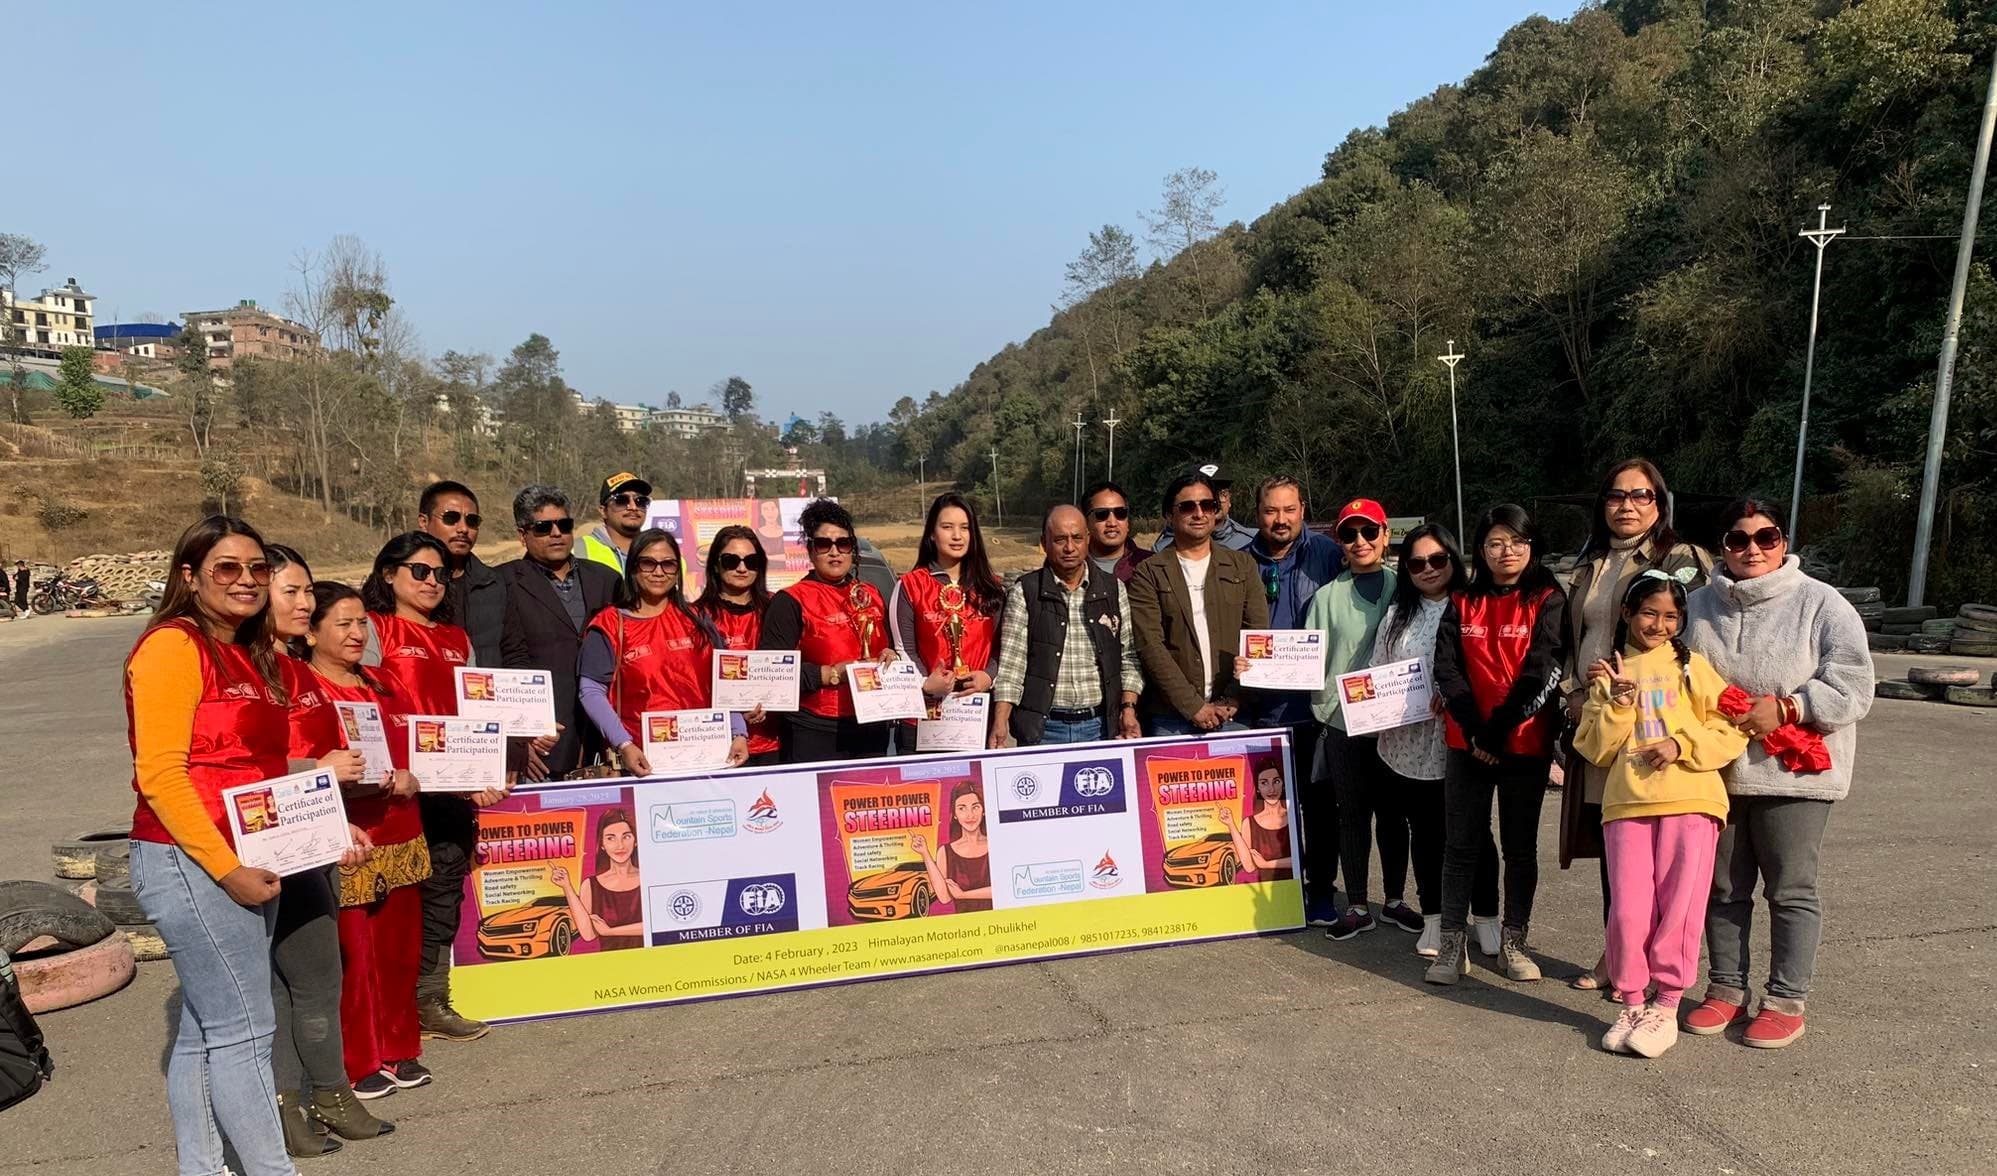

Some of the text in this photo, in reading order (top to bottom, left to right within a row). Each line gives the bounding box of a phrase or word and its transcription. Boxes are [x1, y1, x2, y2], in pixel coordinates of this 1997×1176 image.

[1274, 645, 1312, 653] Certificate
[1274, 653, 1319, 661] Participation
[749, 674, 794, 682] Participation
[1375, 674, 1423, 690] Certificate of
[495, 686, 546, 695] Certificate of
[1376, 683, 1425, 698] Participation
[496, 695, 547, 704] Participation
[679, 724, 724, 734] Certificate of
[447, 735, 499, 744] Certificate of
[679, 733, 726, 742] Participation
[447, 745, 499, 755] Participation
[1158, 767, 1236, 784] POWER TO POWER
[1158, 779, 1238, 805] STEERING
[277, 796, 323, 813] Certificate
[325, 791, 334, 801] of
[843, 792, 930, 810] POWER TO POWER
[280, 806, 337, 826] Participation
[1022, 803, 1105, 819] MEMBER OF FIA
[707, 814, 733, 825] Sports
[844, 805, 933, 834] STEERING
[517, 824, 531, 837] TO
[534, 821, 574, 836] POWER
[655, 828, 703, 839] Federation
[474, 833, 576, 865] STEERING
[506, 867, 546, 876] Empowerment
[484, 876, 513, 884] Adventure
[520, 874, 543, 882] Thrilling
[1060, 873, 1081, 882] Sports
[503, 889, 535, 897] Networking
[1017, 885, 1056, 896] Federation
[679, 923, 774, 941] MEMBER OF FIA
[733, 953, 763, 965] Date:
[765, 952, 772, 961] 4
[775, 947, 824, 961] February
[832, 942, 858, 954] 2023
[868, 934, 924, 949] Himalayan
[927, 927, 981, 941] Motorland
[988, 920, 1037, 936] Dhulikhel
[594, 986, 627, 1000] NASA
[629, 983, 673, 996] Women
[675, 974, 747, 991] Commissions
[756, 970, 787, 983] NASA
[789, 968, 796, 977] 4
[798, 962, 841, 977] Wheeler
[843, 960, 871, 971] Team
[880, 947, 983, 967] www.nasanepal.com
[995, 936, 1070, 953] @nasanepal008
[1080, 928, 1140, 945] 9851017235,
[1141, 922, 1198, 937] 9841238176
